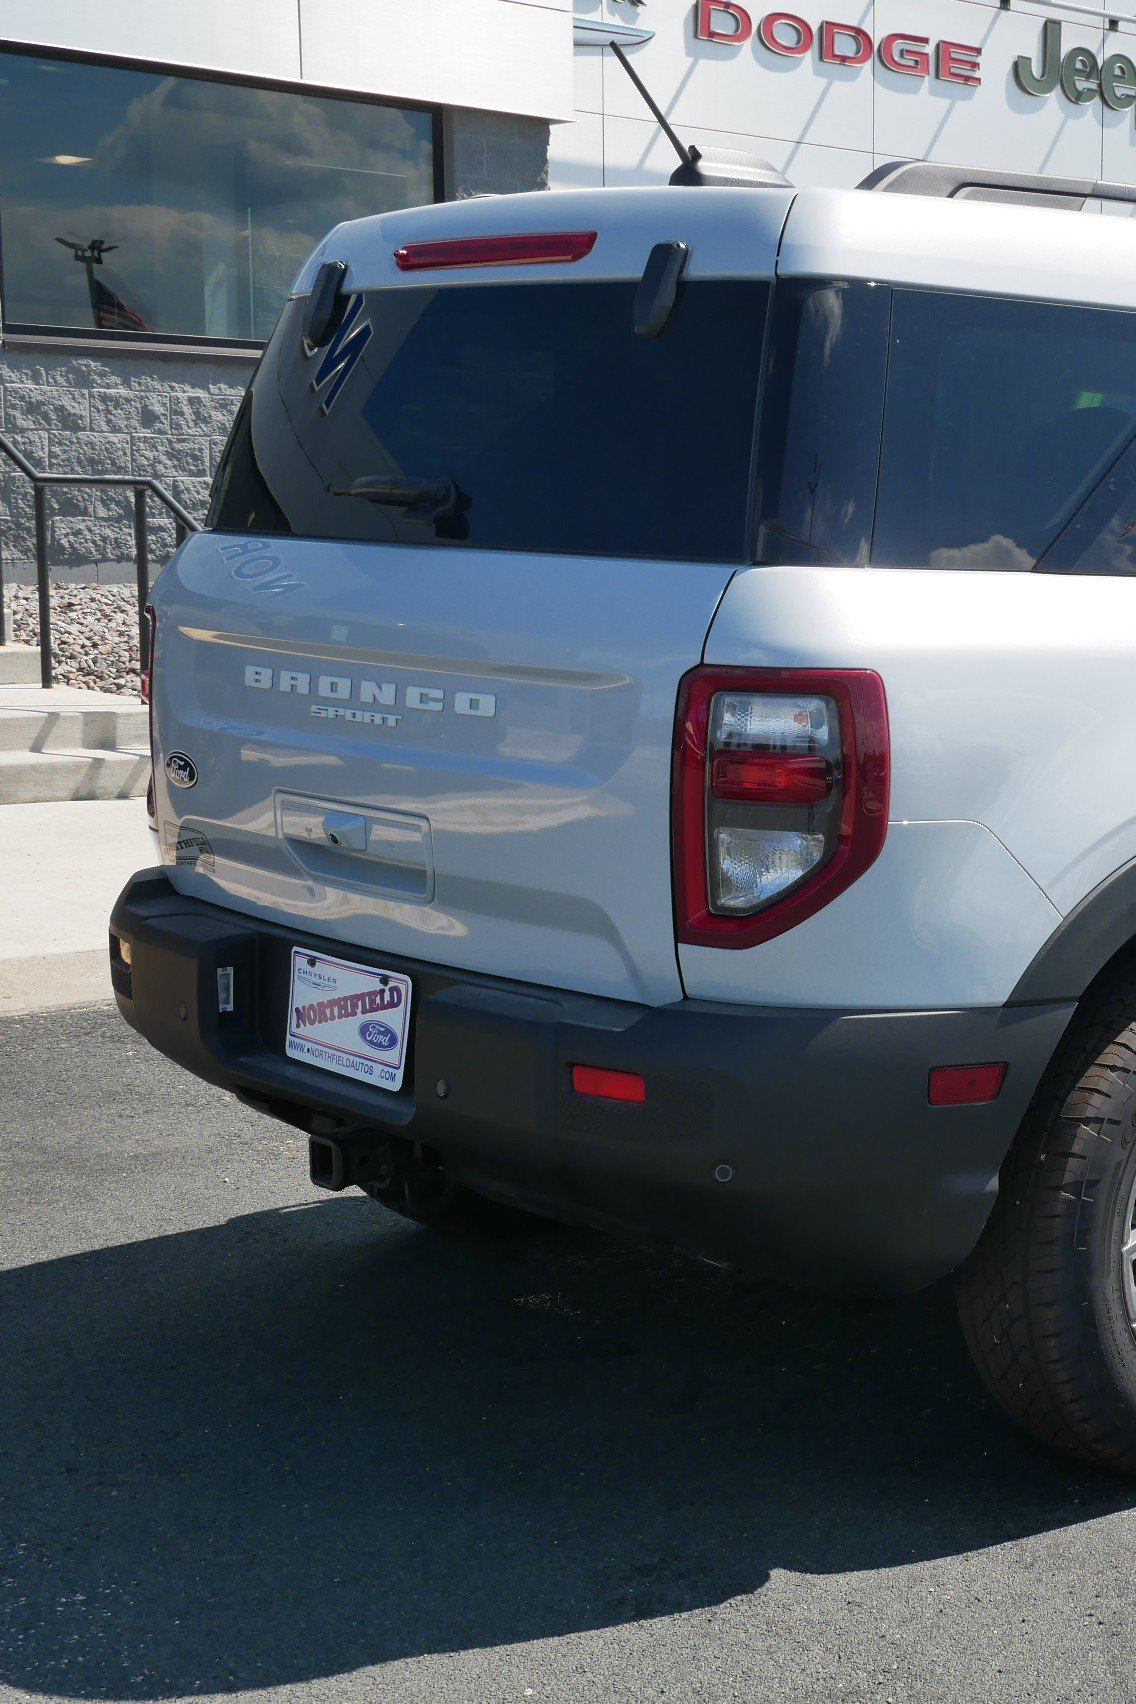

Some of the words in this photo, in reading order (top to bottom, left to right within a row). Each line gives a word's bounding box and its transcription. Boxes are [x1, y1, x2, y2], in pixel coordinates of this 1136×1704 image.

[695, 0, 983, 86] DODGE
[243, 664, 497, 718] BRONCO
[310, 703, 403, 727] SPORT
[297, 967, 338, 985] CHRYSLER
[294, 985, 403, 1029] NORTHFIELD
